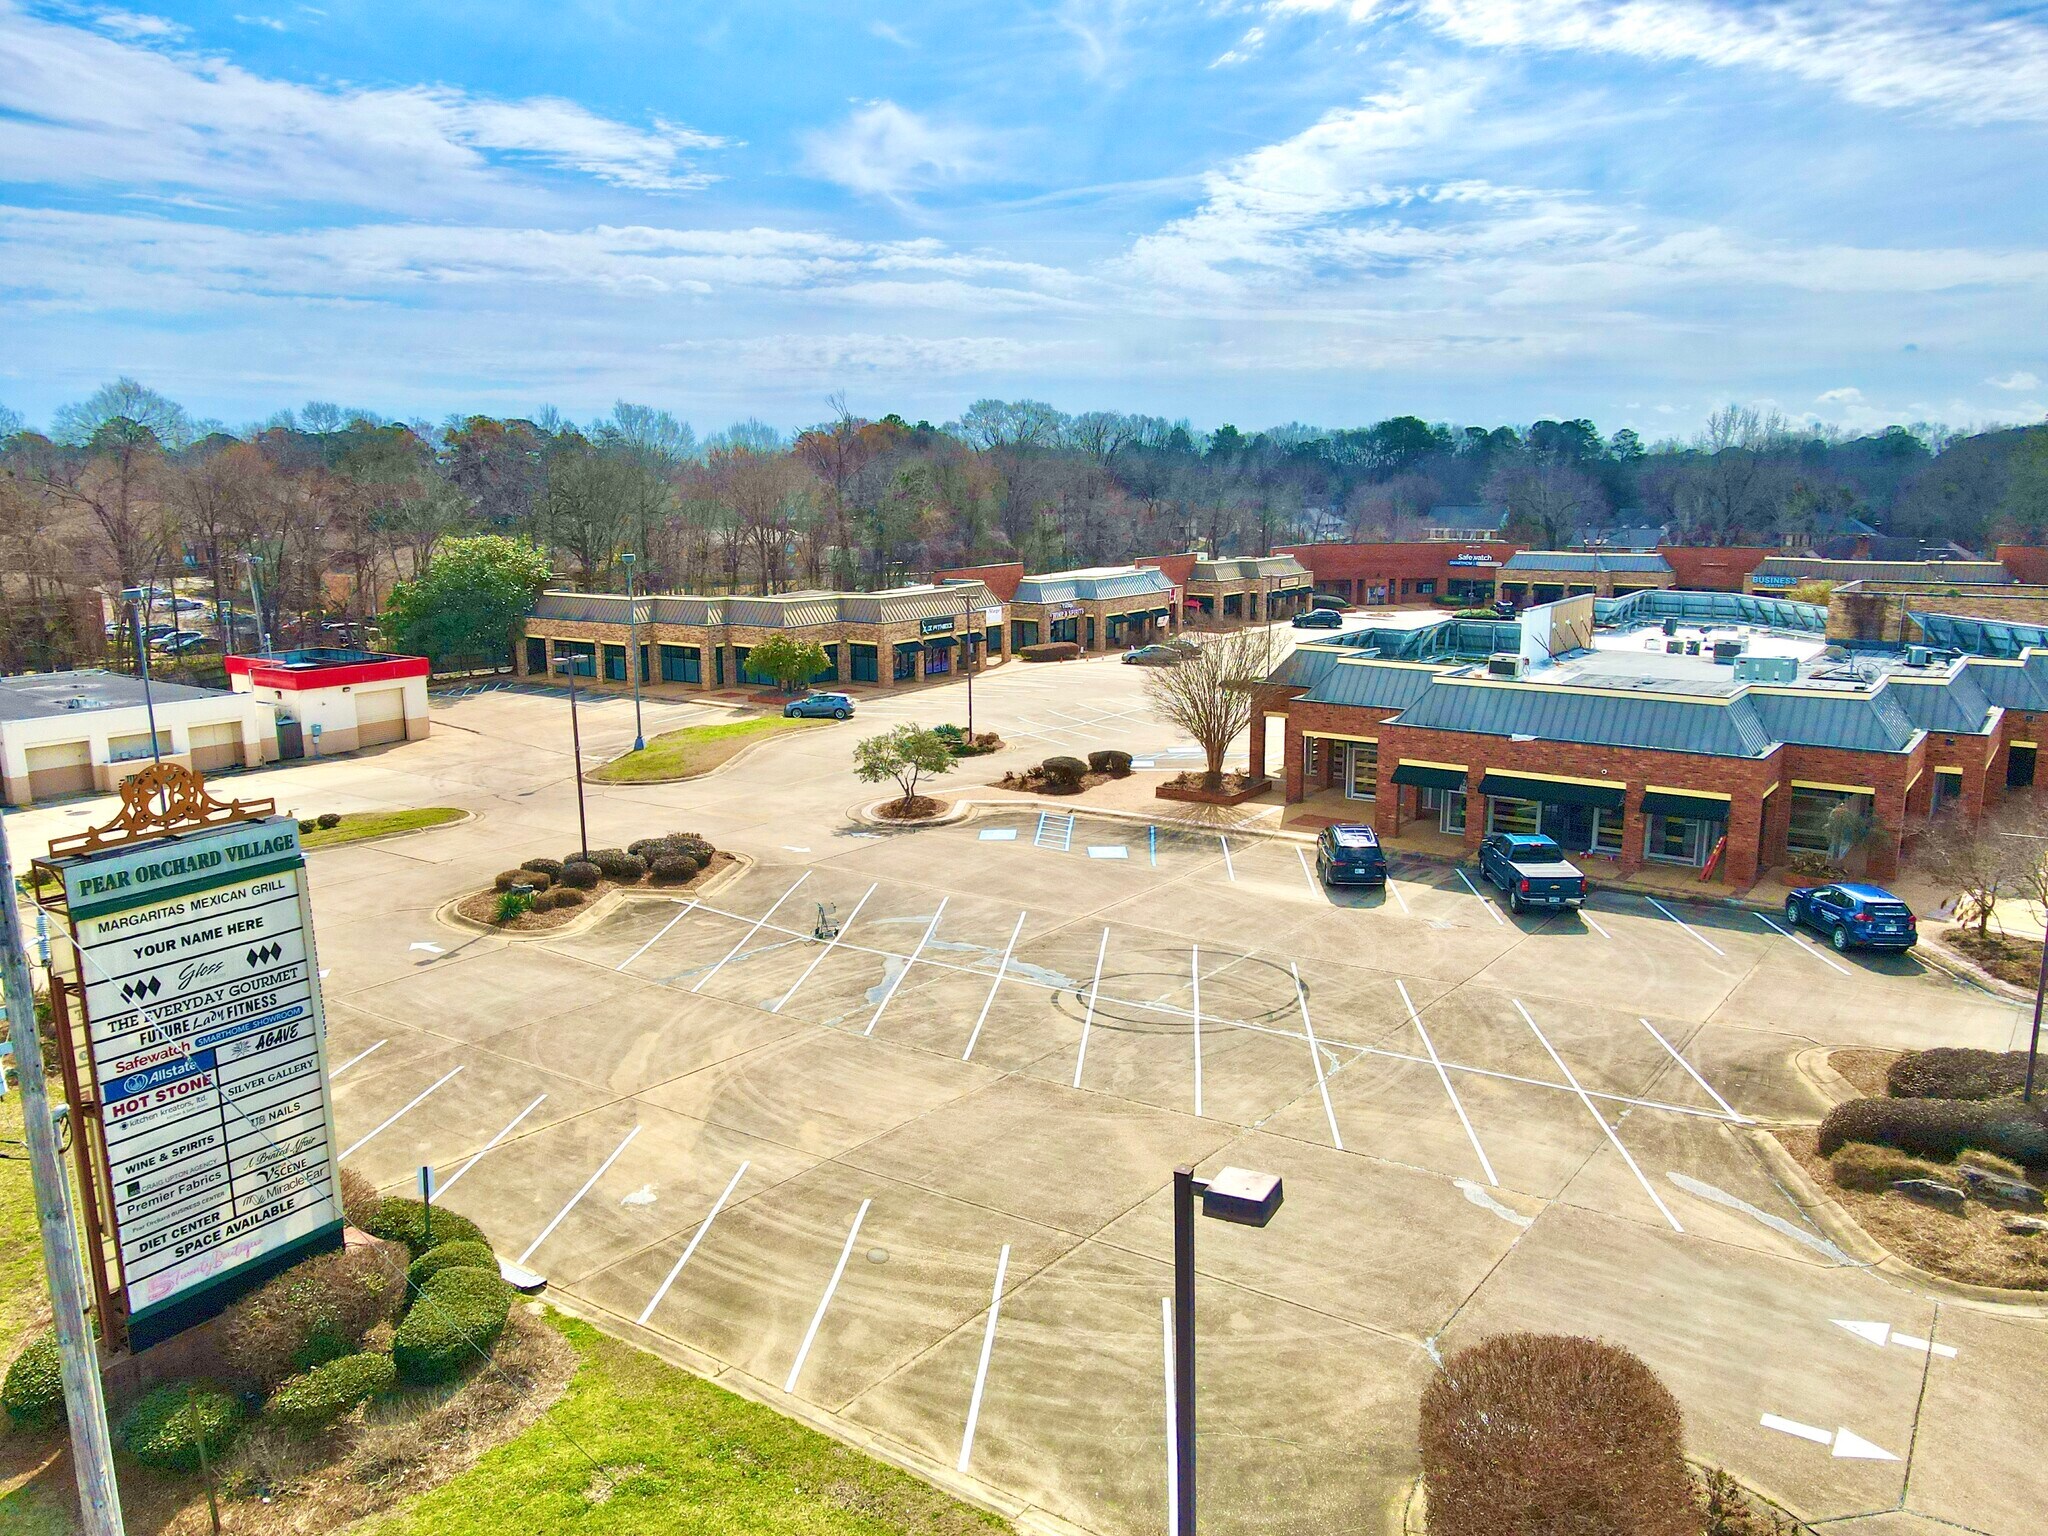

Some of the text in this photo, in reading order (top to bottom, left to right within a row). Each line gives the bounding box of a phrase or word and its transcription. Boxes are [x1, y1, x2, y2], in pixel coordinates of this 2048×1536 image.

[1752, 576, 1798, 585] BUSINESS
[78, 834, 294, 897] PEAR ORCHARD VILLAGE
[98, 879, 286, 933] MARGARITAS MEXICAN GRILL
[133, 917, 264, 960] YOUR NAME HERE
[177, 961, 225, 991] Gloss
[107, 967, 299, 1033] THE EVERYDAY GOURMET
[140, 993, 278, 1045] FUTURE Lady FITNESS
[198, 1008, 301, 1046] SMARTHOME SHOWROOM
[255, 1023, 299, 1051] AGAVE
[115, 1041, 191, 1073] Safewatch
[148, 1061, 197, 1085] Allstate
[112, 1095, 150, 1118] HOT
[155, 1074, 212, 1103] STONE
[228, 1060, 314, 1096] SILVER GALLERY
[129, 1112, 159, 1127] kitchen
[268, 1102, 301, 1121] NAILS
[125, 1135, 215, 1175] WINE & SPIRITS
[127, 1171, 222, 1216] Premier Fabrics
[141, 1180, 164, 1193] CRAIG
[164, 1170, 189, 1183] UPTON
[190, 1158, 218, 1174] AGENCY
[171, 1201, 201, 1217] BUSINESS
[201, 1191, 225, 1204] CENTER
[139, 1211, 220, 1253] DIET CENTER
[174, 1198, 295, 1258] SPACE AVAILABLE
